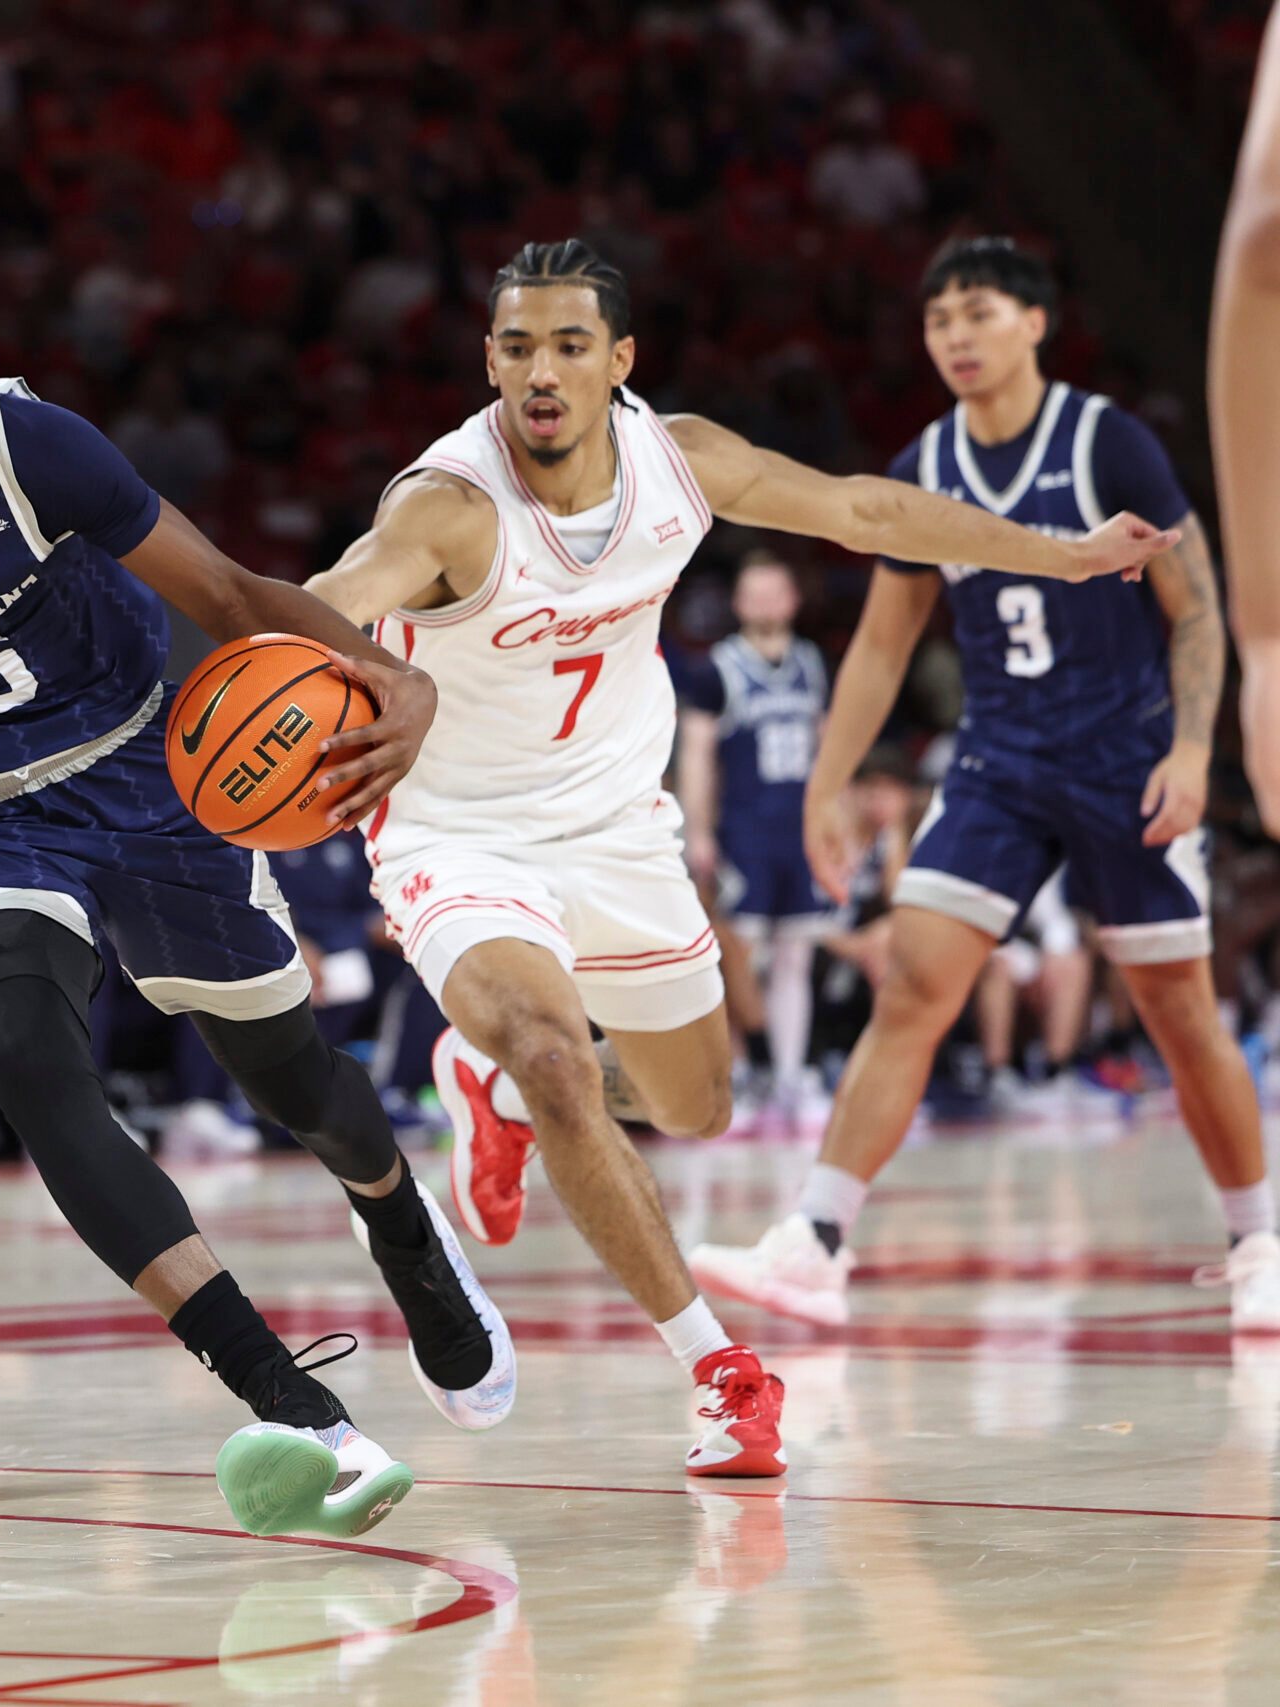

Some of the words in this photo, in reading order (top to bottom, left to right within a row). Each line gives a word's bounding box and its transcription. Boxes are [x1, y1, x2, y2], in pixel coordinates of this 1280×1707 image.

[996, 584, 1053, 679] 3
[551, 652, 604, 741] 7
[218, 703, 314, 805] ELITE
